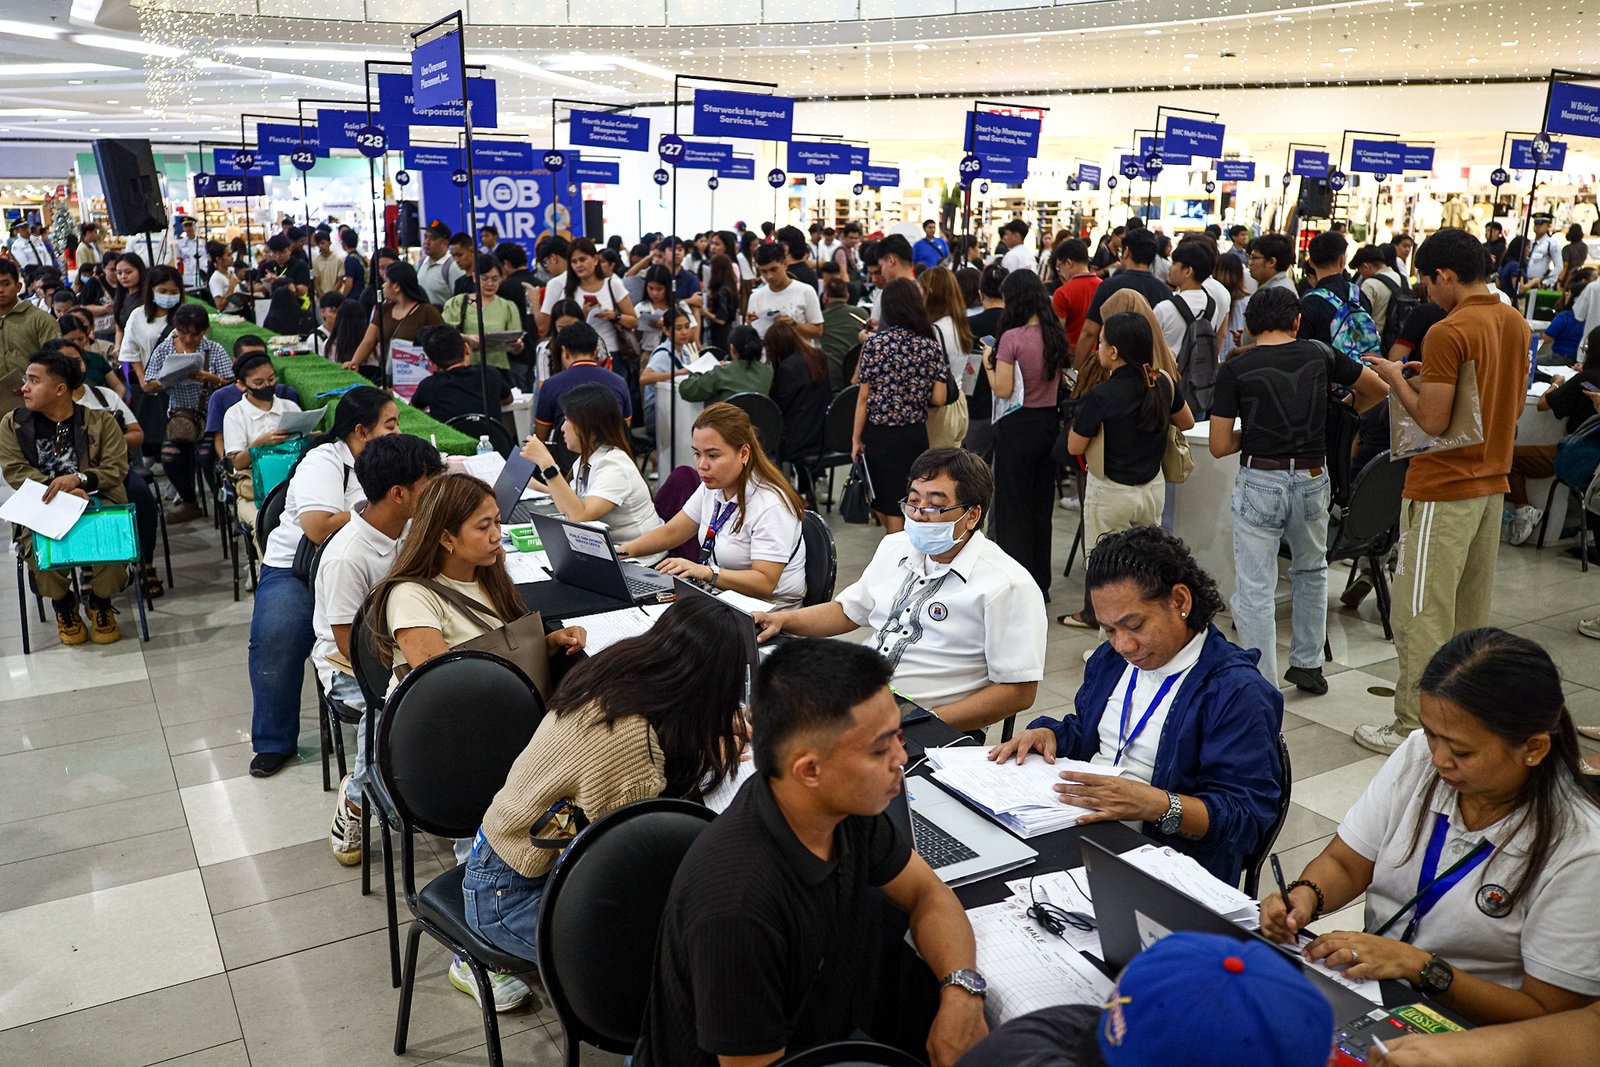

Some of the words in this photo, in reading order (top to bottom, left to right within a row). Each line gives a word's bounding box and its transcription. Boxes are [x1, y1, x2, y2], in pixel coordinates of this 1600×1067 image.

[428, 60, 447, 73] Overseas
[421, 75, 441, 90] Placement,
[441, 72, 449, 82] Inc.
[702, 104, 745, 115] Starworks
[745, 107, 786, 119] Integrated
[1577, 102, 1598, 113] Bridges
[719, 115, 755, 126] Services,
[755, 119, 769, 127] Inc.
[1560, 110, 1590, 121] Manpower
[344, 122, 360, 130] Asia
[581, 117, 600, 125] North
[600, 119, 615, 128] Asia
[615, 121, 639, 129] Central
[593, 126, 628, 136] Manpower
[975, 124, 1001, 135] Start-Up
[1001, 128, 1032, 138] Manpower
[1171, 128, 1184, 137] SMC
[1184, 130, 1218, 141] Multi-Services,
[356, 133, 384, 149] #28
[588, 133, 617, 142] Services,
[991, 135, 1017, 144] Services,
[1190, 138, 1199, 146] Inc.
[660, 143, 682, 156] #27
[1533, 140, 1549, 154] #30
[236, 154, 252, 163] #14
[292, 152, 313, 163] #21
[544, 155, 562, 165] #20
[1146, 158, 1163, 168] #25
[1361, 156, 1385, 165] Philippines,
[960, 159, 980, 172] #26
[1125, 167, 1138, 175] #17
[452, 173, 468, 182] #13
[654, 173, 668, 181] #12
[768, 173, 784, 182] #19
[1331, 176, 1344, 186] #24
[1492, 172, 1506, 181] #23
[217, 180, 243, 192] Exit
[474, 176, 541, 211] JOB
[466, 211, 536, 239] FAIR
[1023, 925, 1047, 945] MALE
